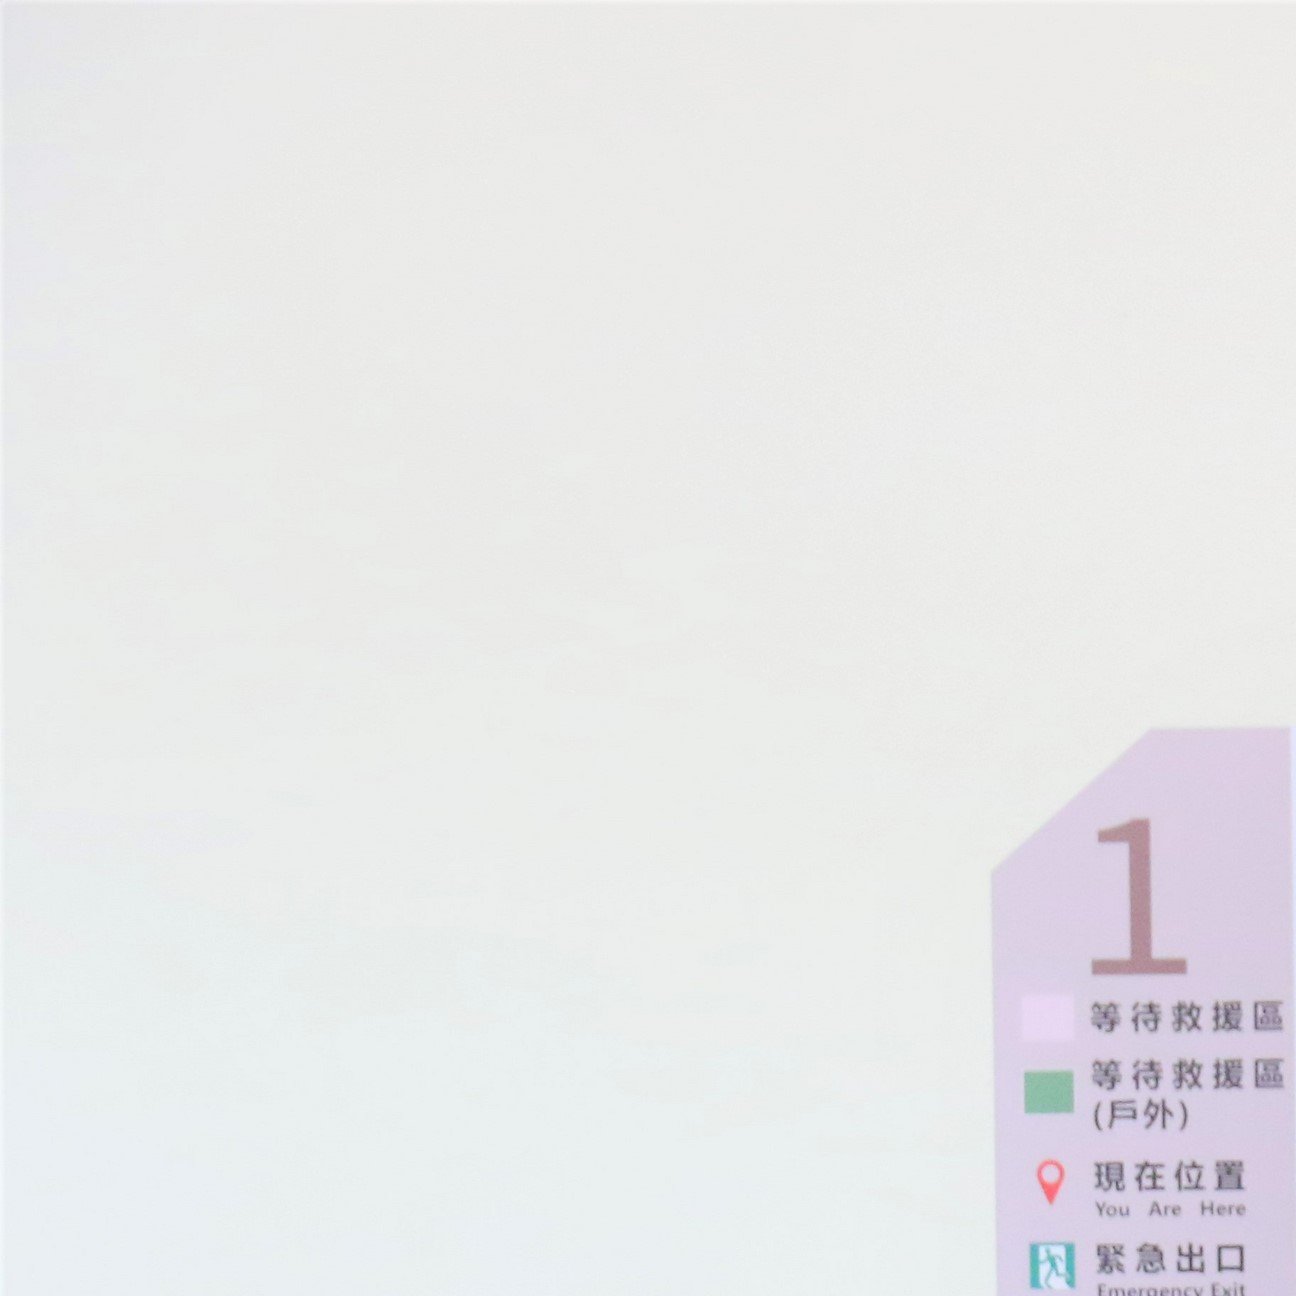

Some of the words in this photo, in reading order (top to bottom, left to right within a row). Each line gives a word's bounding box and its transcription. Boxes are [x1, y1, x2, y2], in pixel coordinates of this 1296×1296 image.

[1091, 818, 1188, 976] 1
[1091, 1001, 1283, 1033] 等待救援區
[1092, 1058, 1283, 1091] 等待救援區
[1094, 1098, 1188, 1131] (戶外)
[1095, 1160, 1244, 1192] 現在位置
[1095, 1202, 1130, 1218] You
[1149, 1201, 1181, 1217] Are
[1200, 1201, 1246, 1216] Here
[1096, 1243, 1245, 1274] 緊急出口
